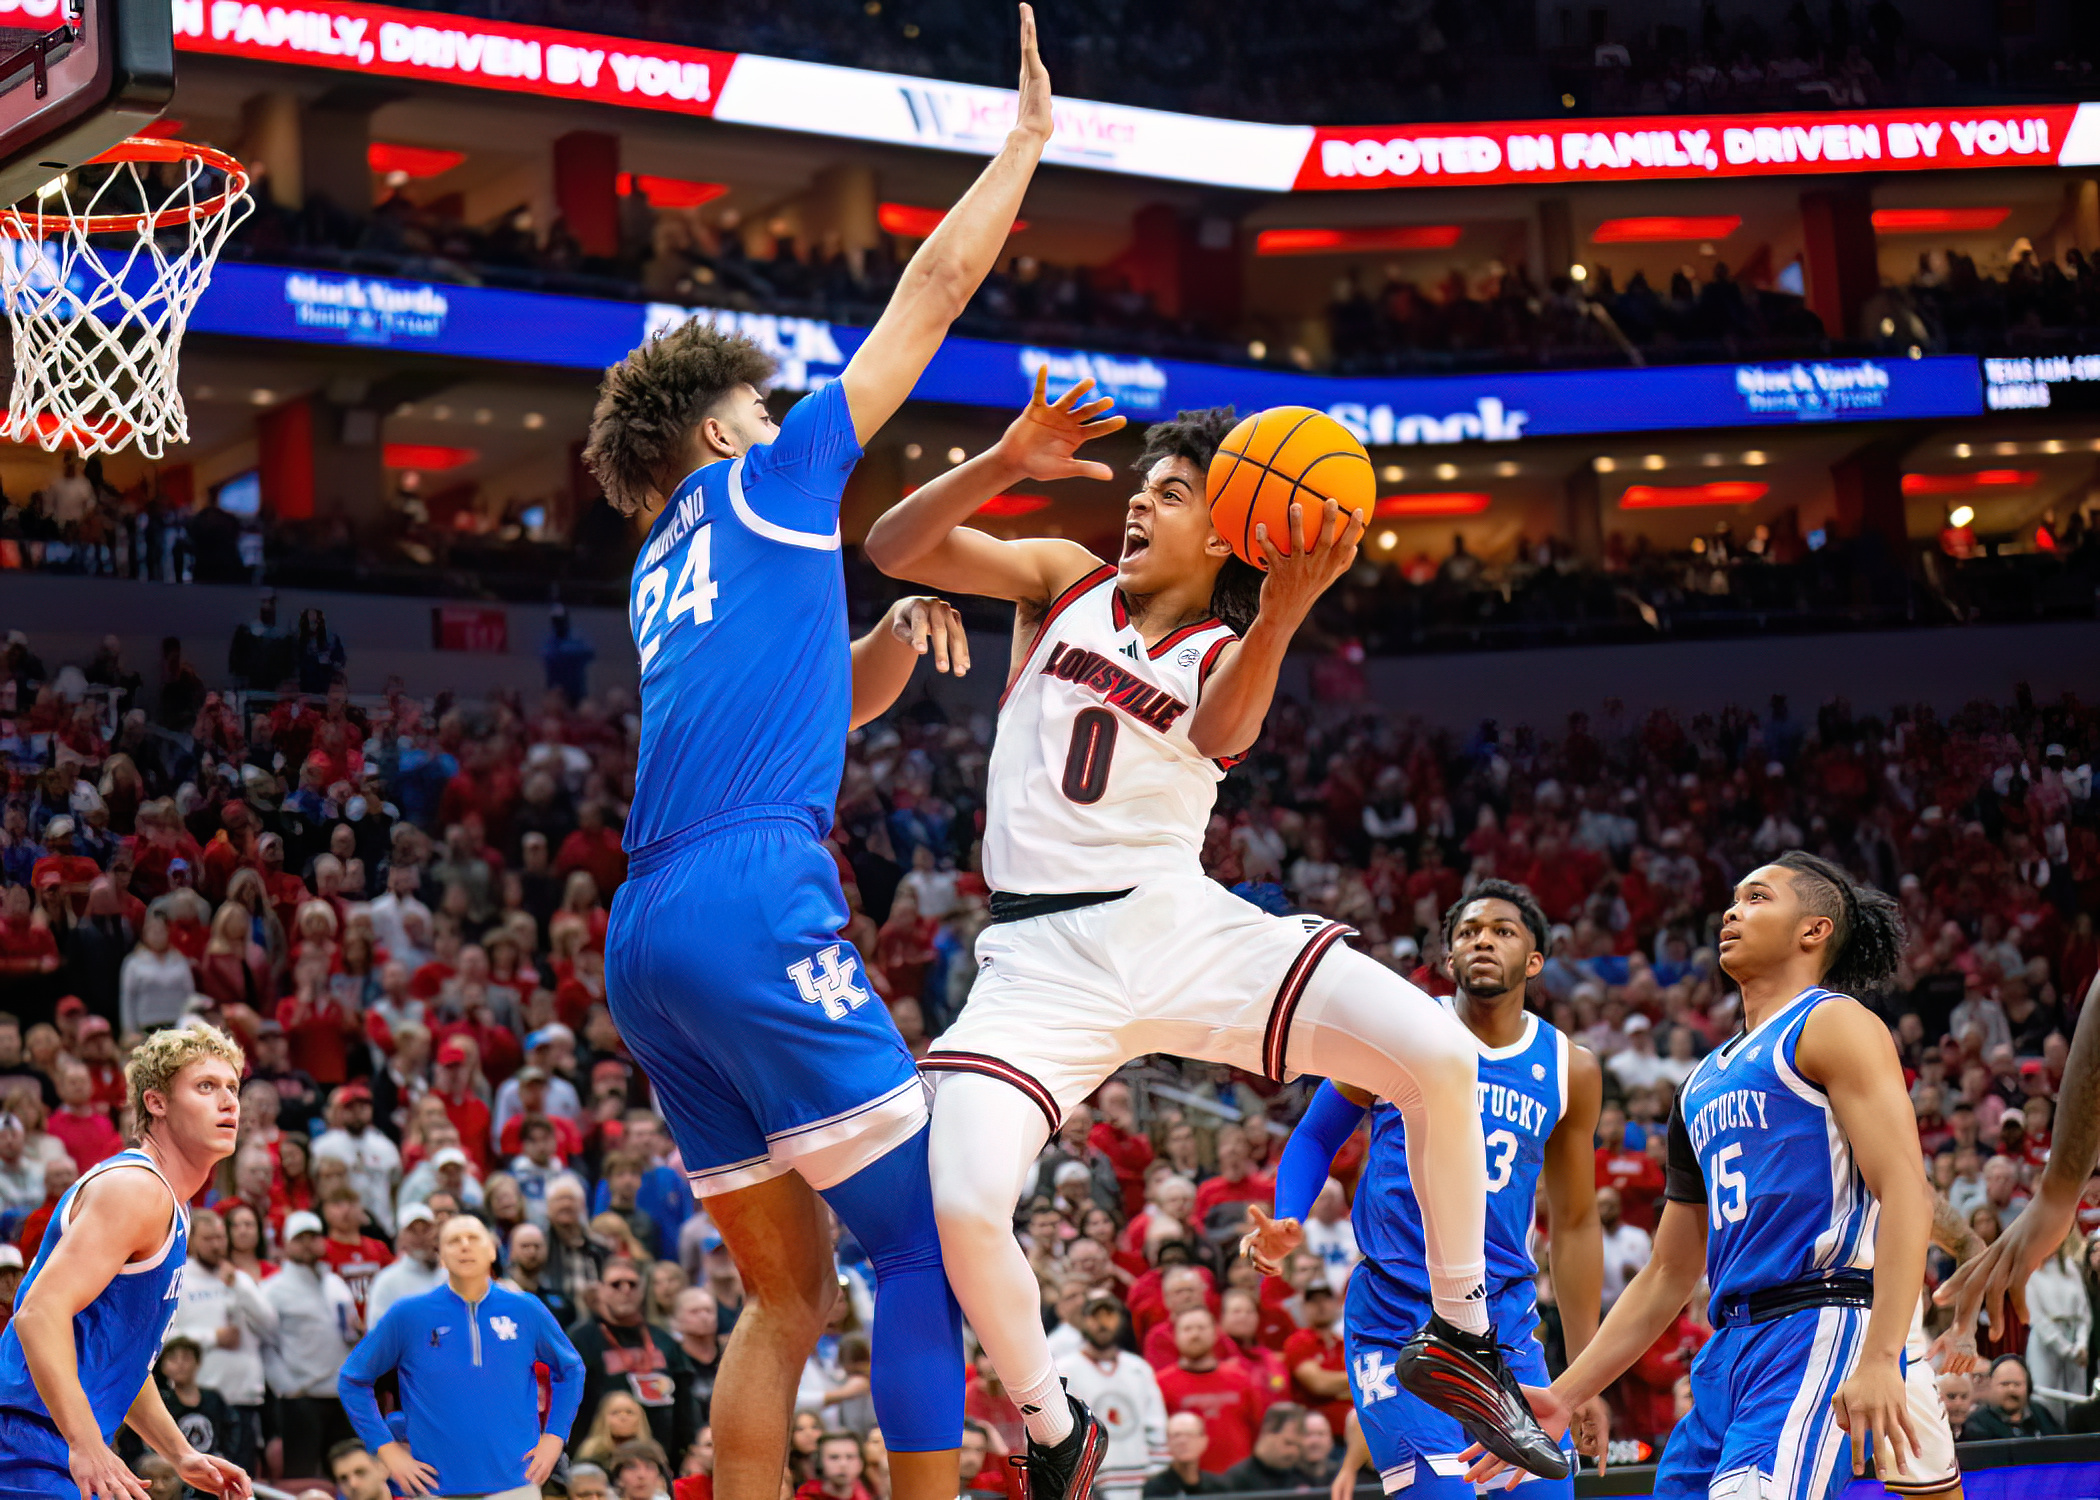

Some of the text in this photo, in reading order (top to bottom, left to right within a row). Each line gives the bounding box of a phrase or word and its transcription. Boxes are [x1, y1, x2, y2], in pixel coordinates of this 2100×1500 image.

[211, 0, 374, 64] FAMILY,
[379, 22, 542, 80] DRIVEN
[546, 44, 604, 88] BY
[608, 52, 711, 102] YOU!
[1321, 118, 2050, 177] ROOTED IN FAMILY, DRIVEN BY YOU!
[636, 523, 718, 675] 24
[1039, 640, 1190, 735] LOUISVILLE
[1062, 706, 1119, 806] 0
[786, 944, 870, 1021] UK
[1478, 1082, 1548, 1138] TUCKY
[1688, 1089, 1769, 1155] KENTUCKY
[1486, 1128, 1519, 1193] 3
[1710, 1142, 1748, 1231] 15
